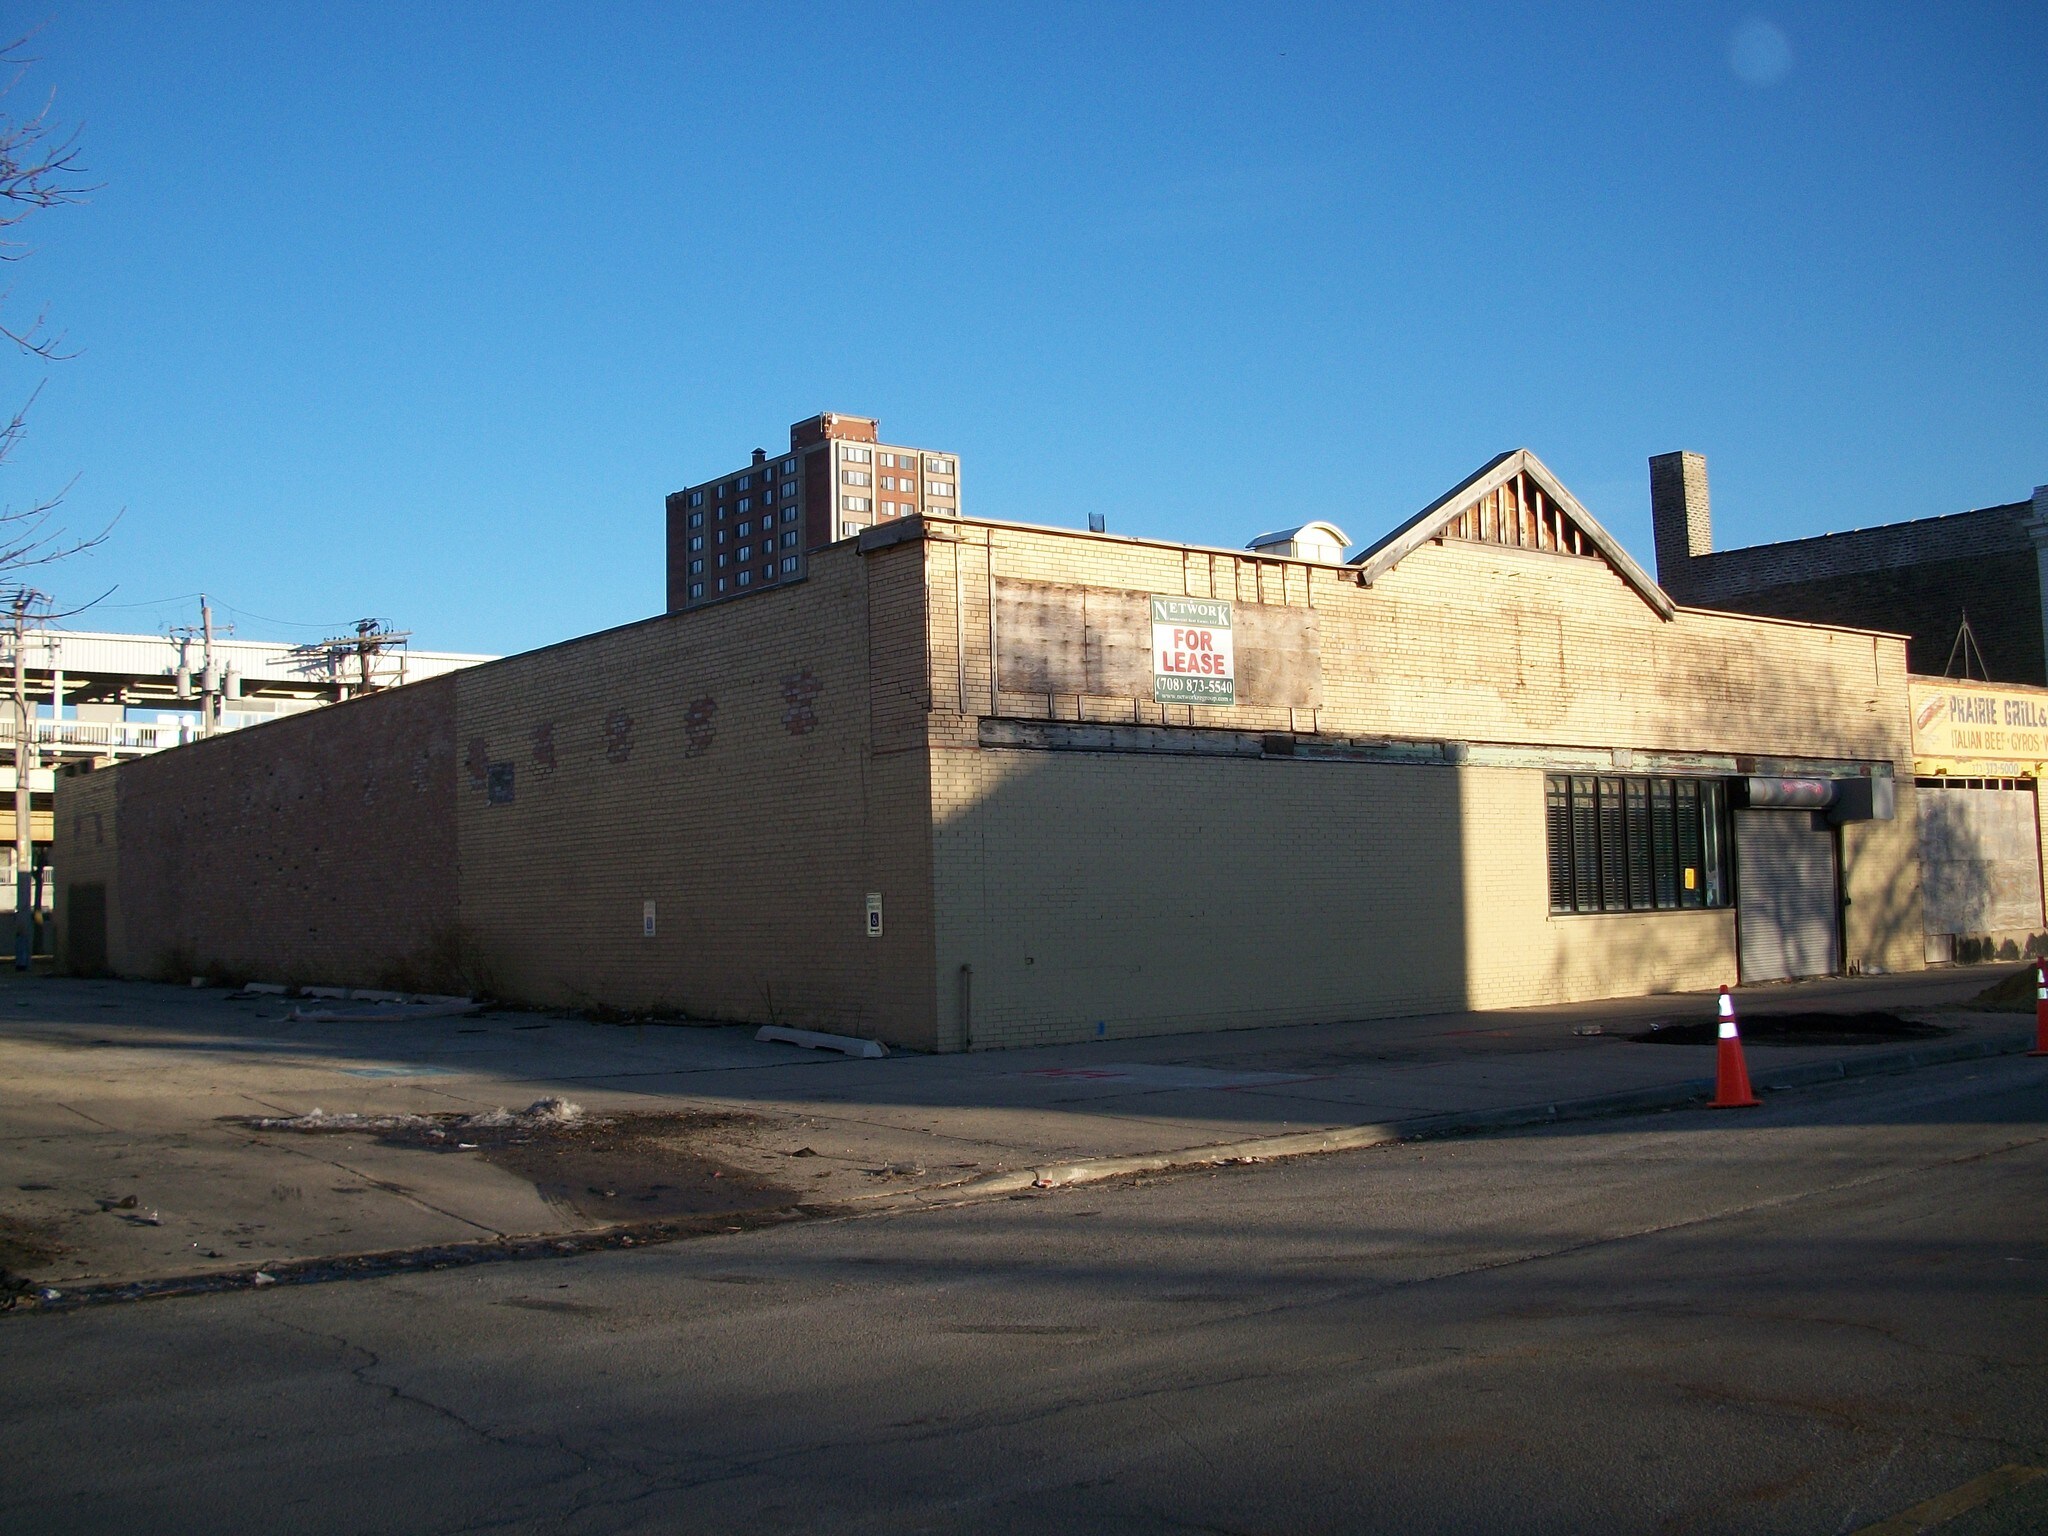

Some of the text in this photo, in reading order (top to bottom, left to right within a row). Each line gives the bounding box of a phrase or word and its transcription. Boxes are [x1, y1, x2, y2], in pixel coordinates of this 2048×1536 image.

[1154, 600, 1230, 626] NETWORK
[1174, 629, 1213, 652] FOR
[1163, 651, 1225, 675] LEASE
[1156, 677, 1232, 694] (708) 873-5540
[1950, 695, 2048, 728] PRAIRIE GRILL &
[1951, 730, 1982, 749] ITALIAN
[1985, 731, 2005, 750] BEEF
[2011, 732, 2040, 752] GYROS
